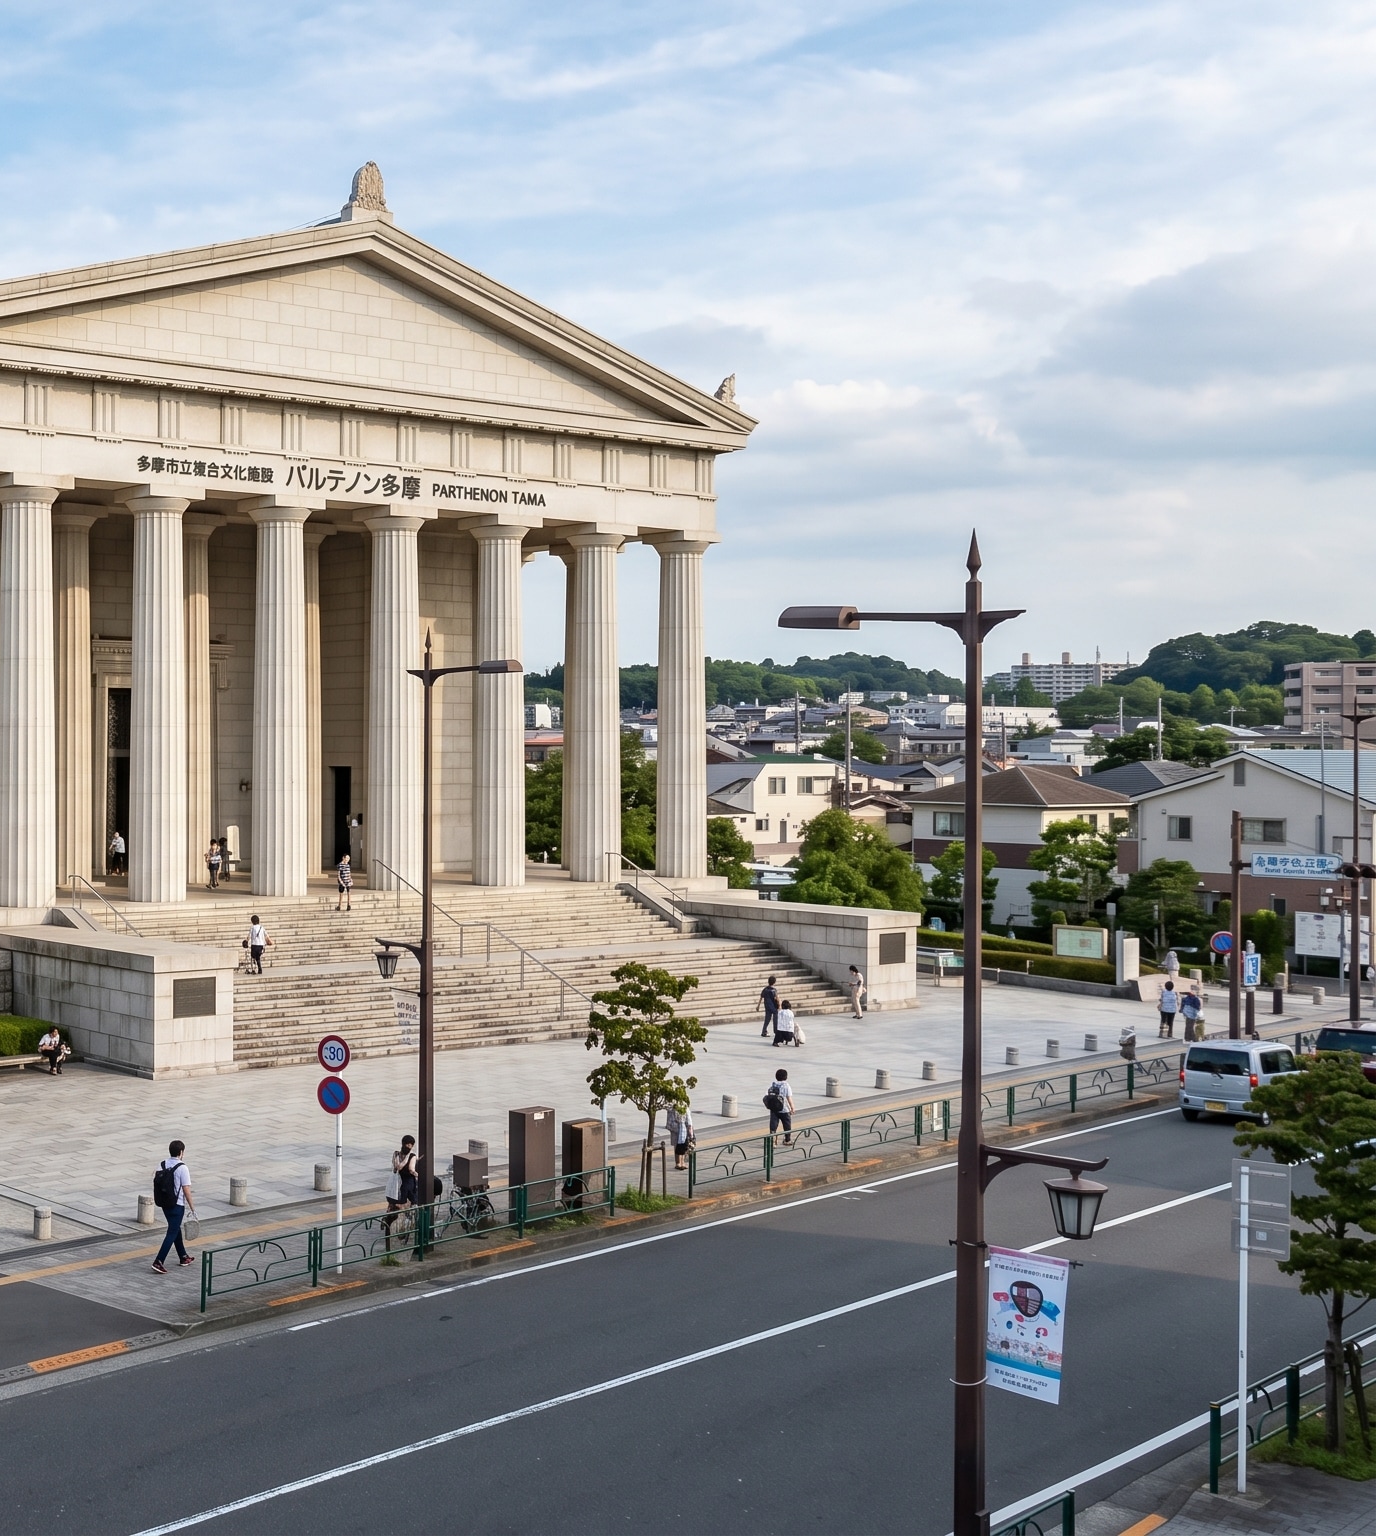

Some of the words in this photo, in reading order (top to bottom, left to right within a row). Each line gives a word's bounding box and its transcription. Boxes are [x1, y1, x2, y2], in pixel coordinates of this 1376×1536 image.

[285, 464, 421, 500] パルテノン多摩
[432, 483, 508, 504] PARTHENON
[512, 491, 546, 507] TAMA
